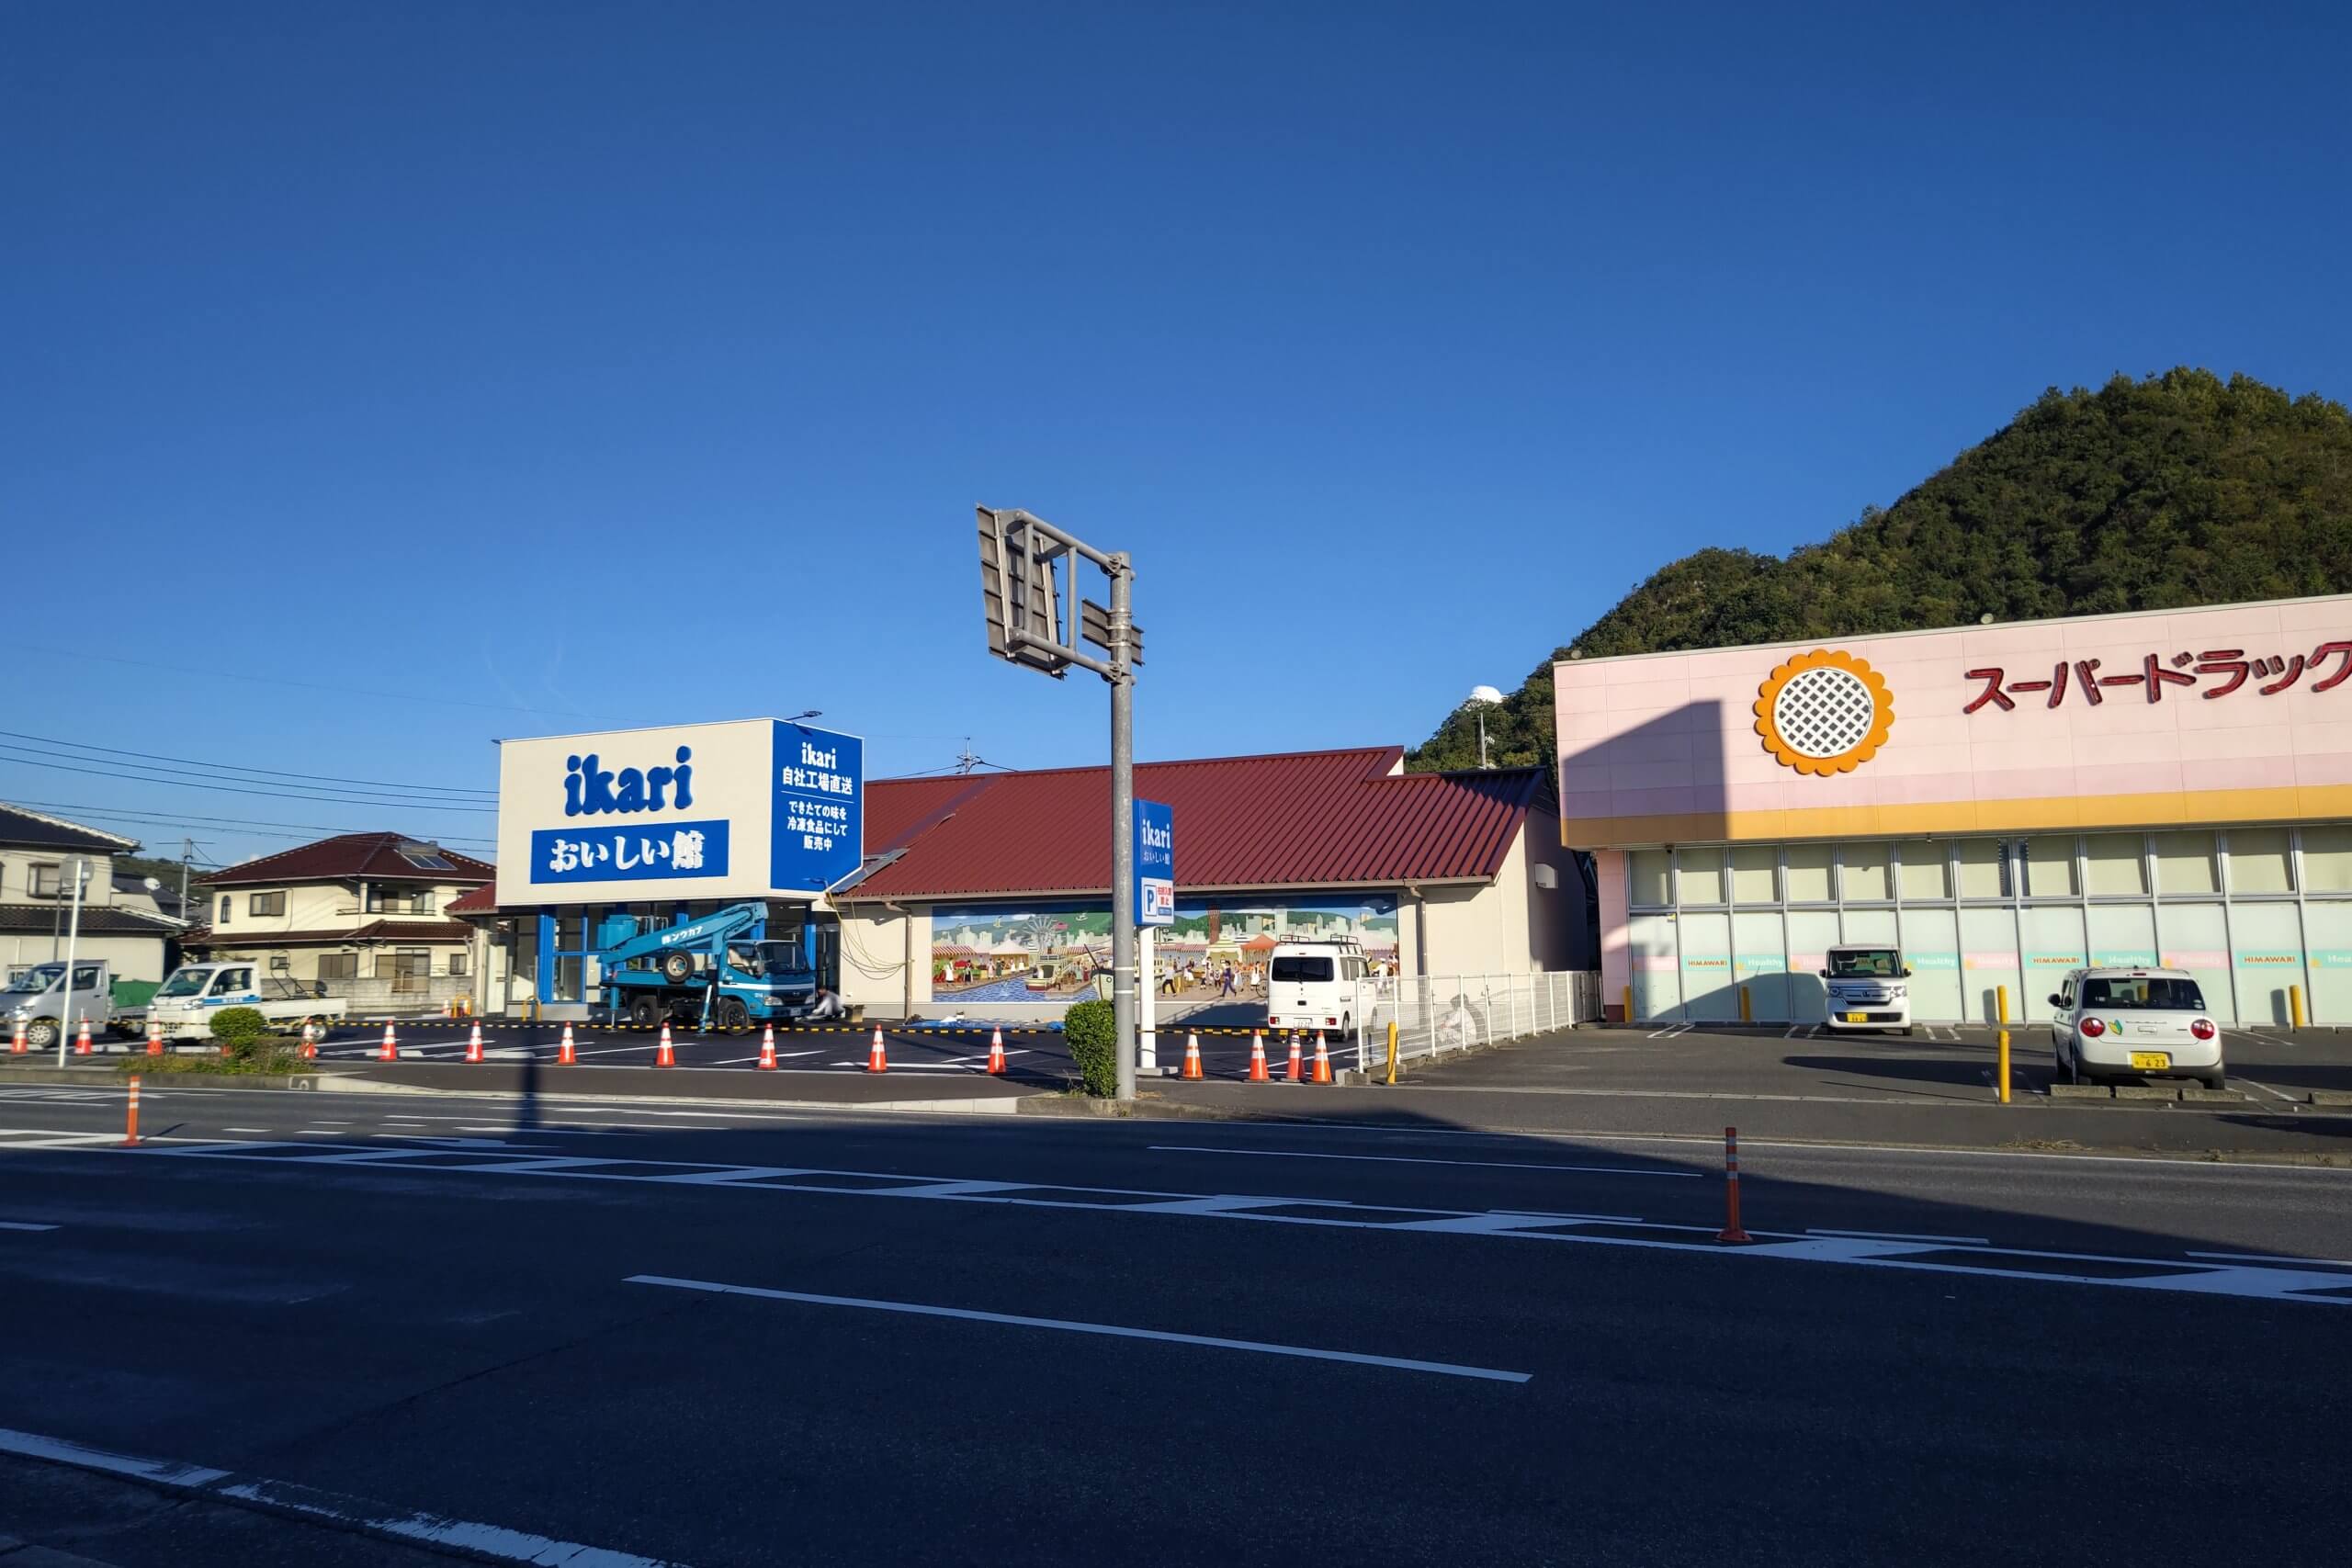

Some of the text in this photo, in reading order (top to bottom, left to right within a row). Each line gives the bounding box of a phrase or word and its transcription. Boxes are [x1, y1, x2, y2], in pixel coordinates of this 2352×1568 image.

[801, 741, 836, 770] ikari
[564, 745, 693, 817] ikari
[782, 765, 853, 795] 自社工場直送
[788, 800, 847, 820] できたての味を
[786, 816, 848, 836] 冷凍食品にして
[1142, 818, 1171, 850] ikari
[548, 829, 705, 873] おいしい館
[803, 834, 832, 852] 販売中
[1147, 889, 1155, 913] P
[1688, 959, 1727, 967] HIMAWARI
[1748, 957, 1783, 968] Healthy
[1917, 956, 1956, 967] Healthy
[2031, 956, 2080, 964] HIMAWARI
[2109, 954, 2151, 965] Healthy
[2245, 955, 2296, 964] HIMAWARI
